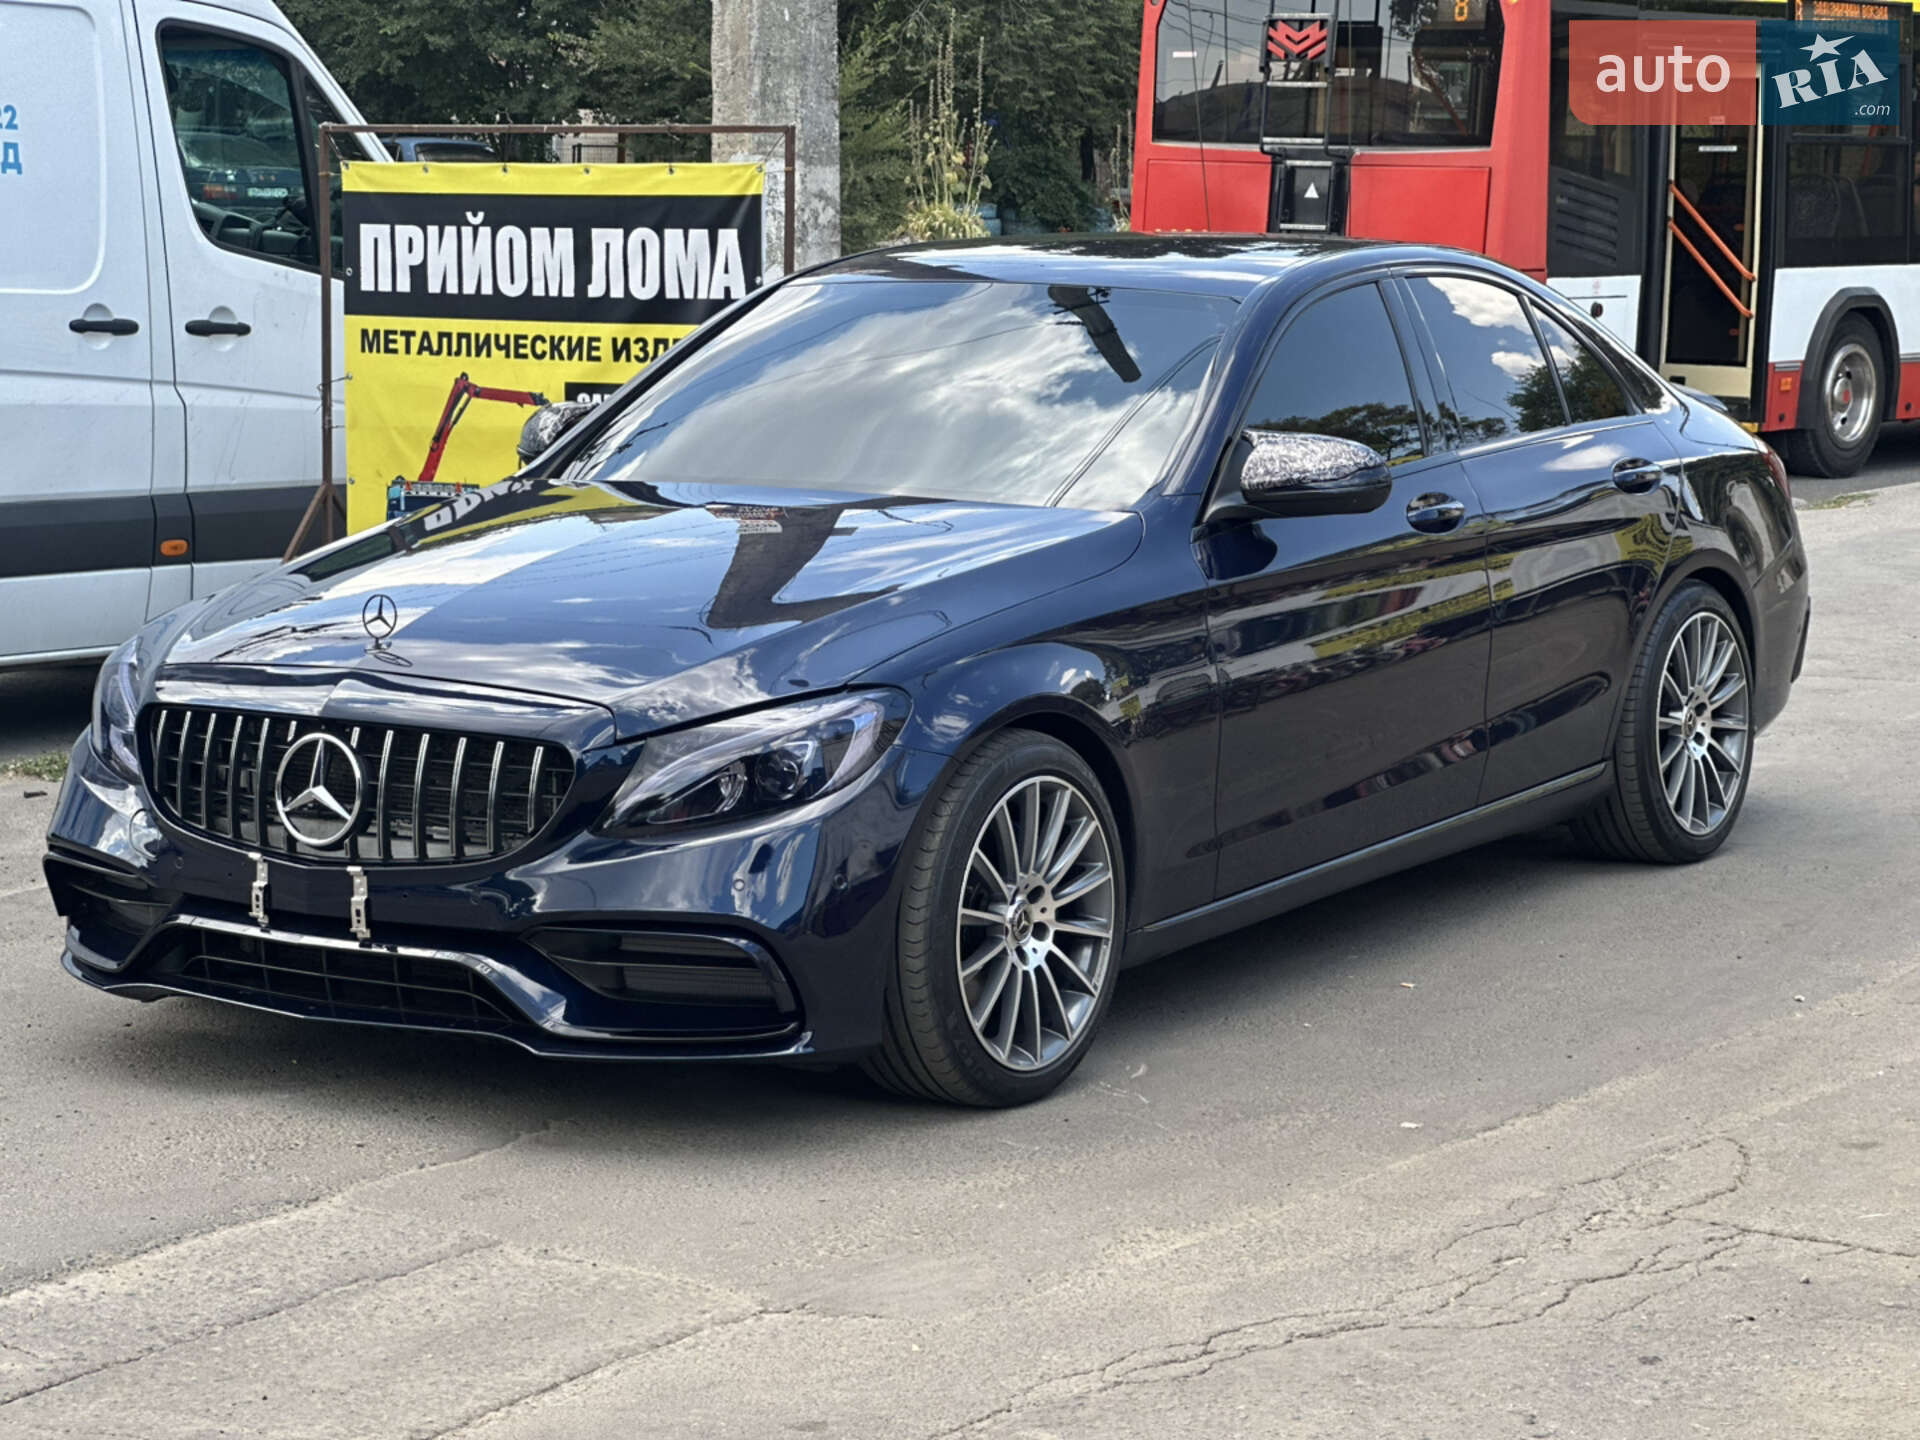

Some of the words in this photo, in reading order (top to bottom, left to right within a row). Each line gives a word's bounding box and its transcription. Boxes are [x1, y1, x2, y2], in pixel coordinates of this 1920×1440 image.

[0, 104, 18, 130] 2
[359, 210, 576, 298] ПРИЙОМ
[587, 226, 746, 300] ЛОМА
[360, 328, 602, 363] МЕТАЛЛИЧЕСКИЕ
